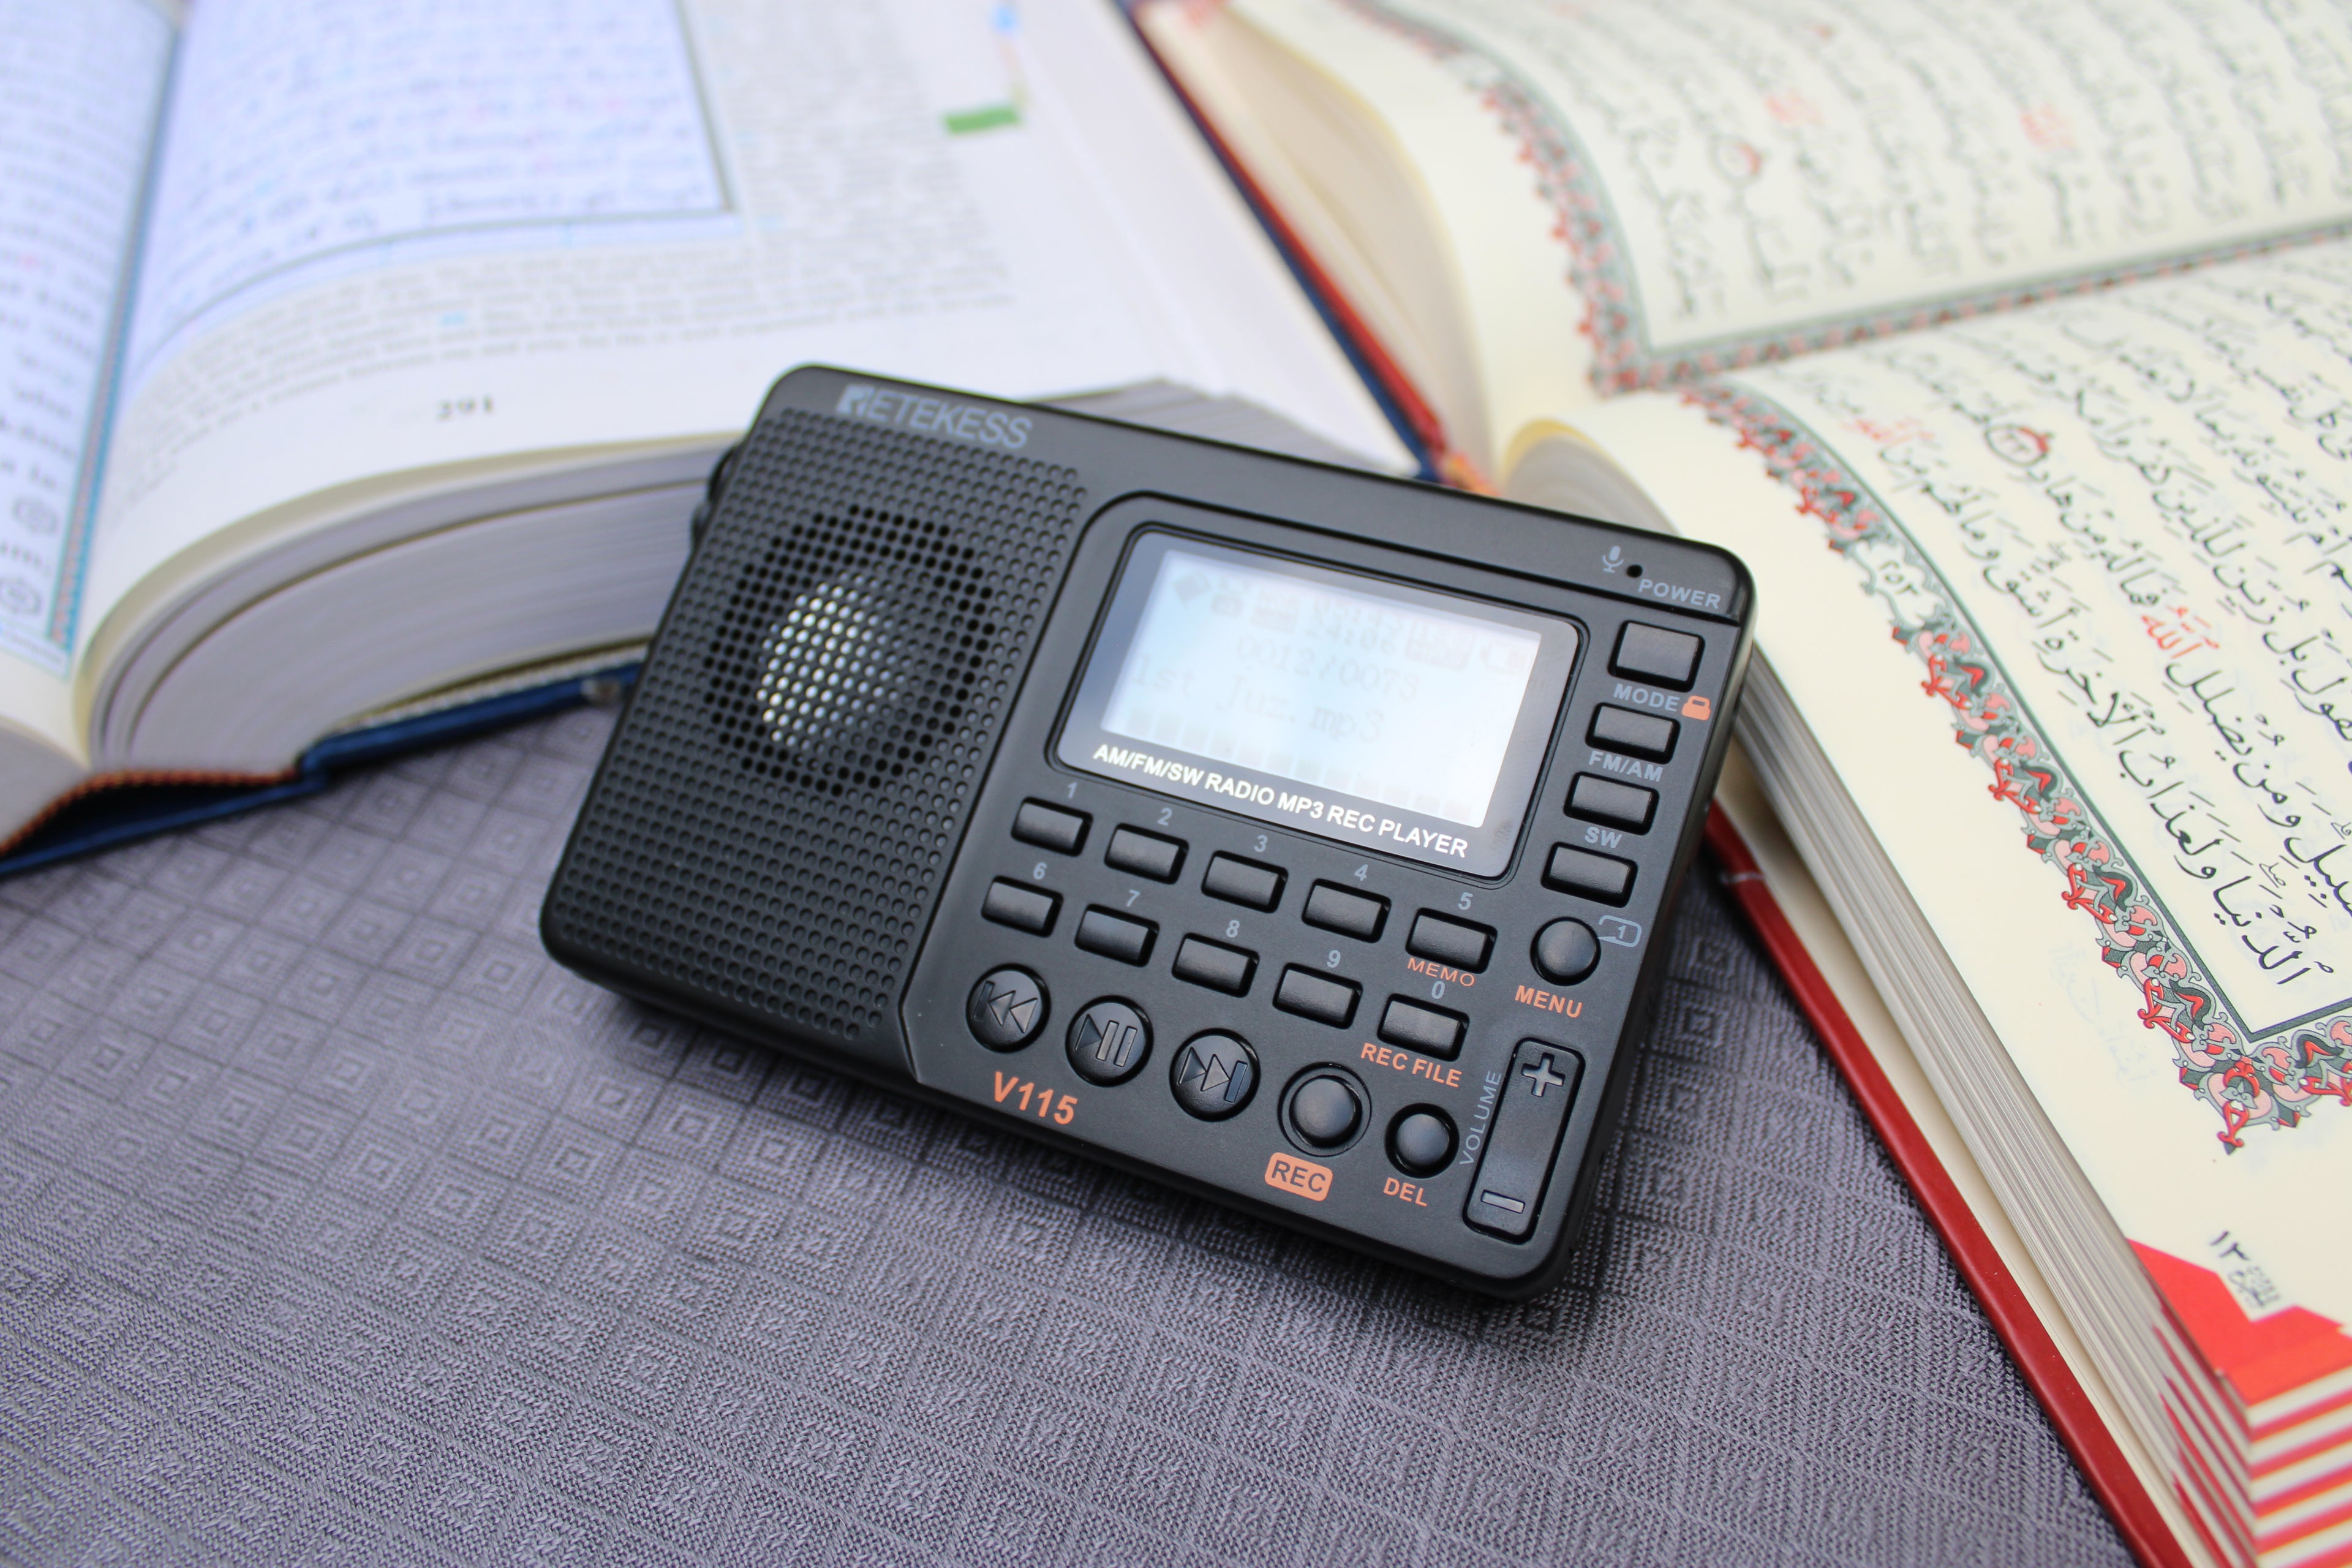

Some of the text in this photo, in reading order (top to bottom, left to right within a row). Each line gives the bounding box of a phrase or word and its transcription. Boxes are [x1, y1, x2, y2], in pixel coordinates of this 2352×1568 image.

[836, 383, 1032, 448] RETEKESS
[1638, 578, 1721, 609] POWER
[1613, 684, 1680, 712] MODE
[1589, 750, 1664, 782] FM/AM
[1067, 782, 1077, 799] 1
[1093, 744, 1469, 858] AM/FM/SW RADIO MP3 REC PLAYER
[1157, 808, 1172, 827] 2
[1254, 834, 1268, 854] 3
[1585, 826, 1622, 848] SW
[1033, 862, 1047, 881] 6
[1353, 863, 1368, 882] 4
[1127, 890, 1141, 908] 7
[1458, 892, 1473, 911] 5
[1225, 919, 1240, 939] 8
[1326, 949, 1341, 969] 9
[1408, 958, 1475, 987] MEMO
[1431, 981, 1446, 1000] 0
[1515, 984, 1583, 1019] MENU
[1360, 1042, 1463, 1088] REC FILE
[993, 1071, 1079, 1126] V115
[1459, 1069, 1502, 1165] VOLUME
[1270, 1159, 1327, 1193] REC
[1382, 1177, 1429, 1207] DEL
